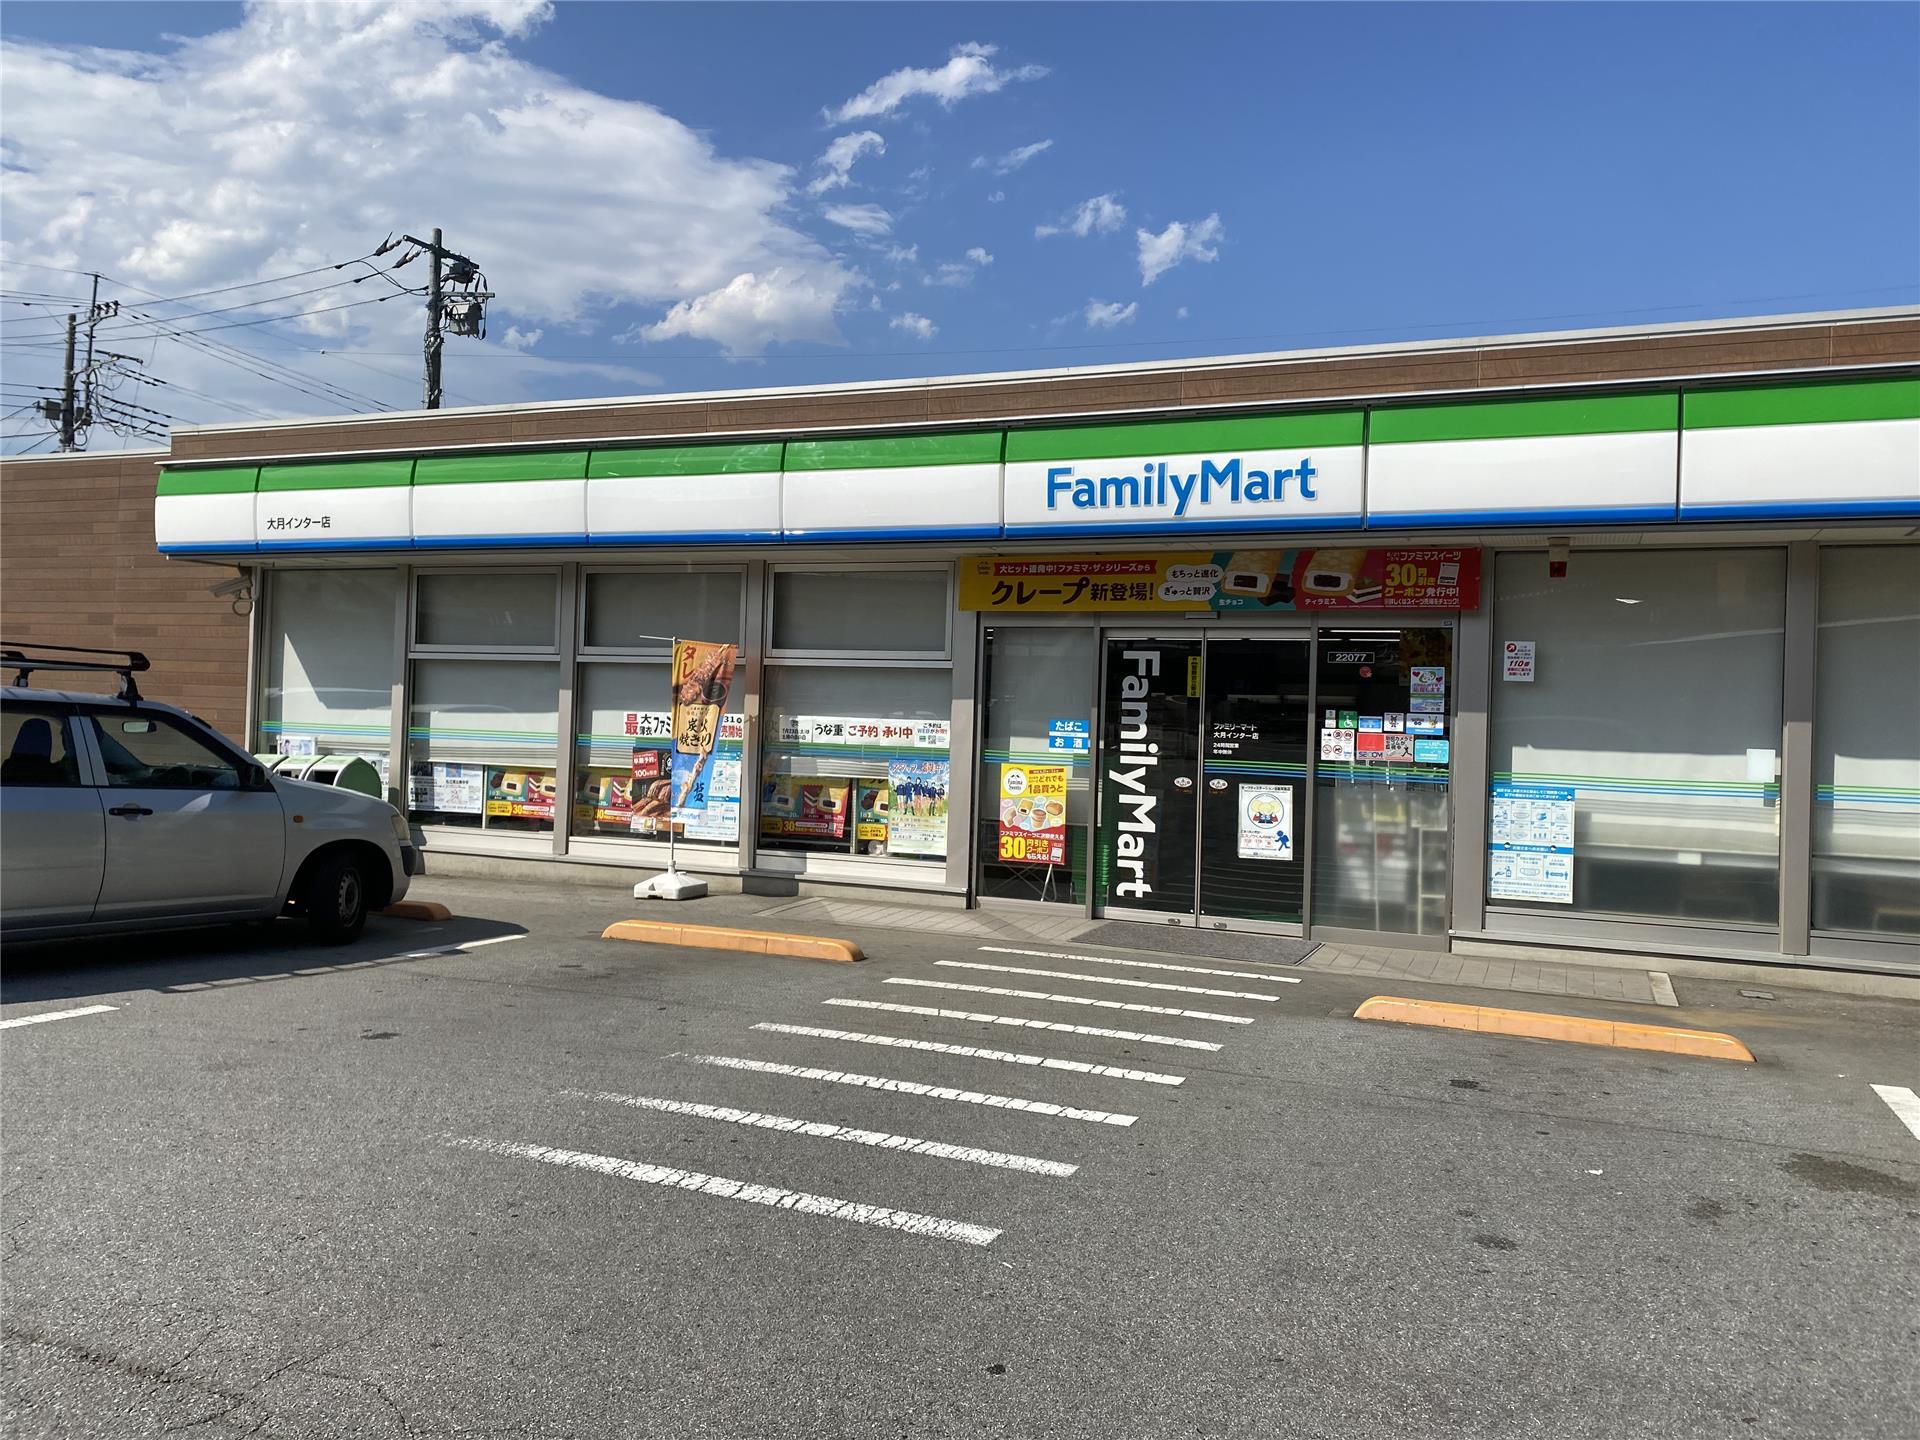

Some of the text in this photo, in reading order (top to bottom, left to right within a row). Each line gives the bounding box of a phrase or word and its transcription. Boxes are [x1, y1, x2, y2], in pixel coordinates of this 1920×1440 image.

[1047, 457, 1318, 518] FamilyMart
[267, 516, 331, 530] 大月インター店
[1400, 551, 1461, 561] ファミマスイーツ
[1171, 569, 1219, 579] もちっと進化
[1385, 563, 1417, 586] 30
[991, 577, 1154, 605] クレープ新登場!
[1164, 585, 1211, 596] ぎゅっと贅沢
[1384, 587, 1460, 598] クーポン発行中!
[1304, 598, 1337, 606] ティラミス
[682, 645, 697, 679] タレ
[1335, 653, 1367, 662] 22077
[814, 724, 844, 737] うな重
[847, 725, 878, 738] ご予約
[882, 726, 913, 739] 承り中
[1055, 720, 1083, 732] たばこ
[1213, 723, 1258, 732] ファミリーマート
[1213, 731, 1260, 740] 大月インター店
[1038, 775, 1064, 783] どれでも
[1109, 650, 1161, 898] FamilyMart
[1028, 784, 1064, 794] 1品買うと
[1000, 836, 1049, 859] 30 円引き
[1026, 846, 1049, 854] クーポン
